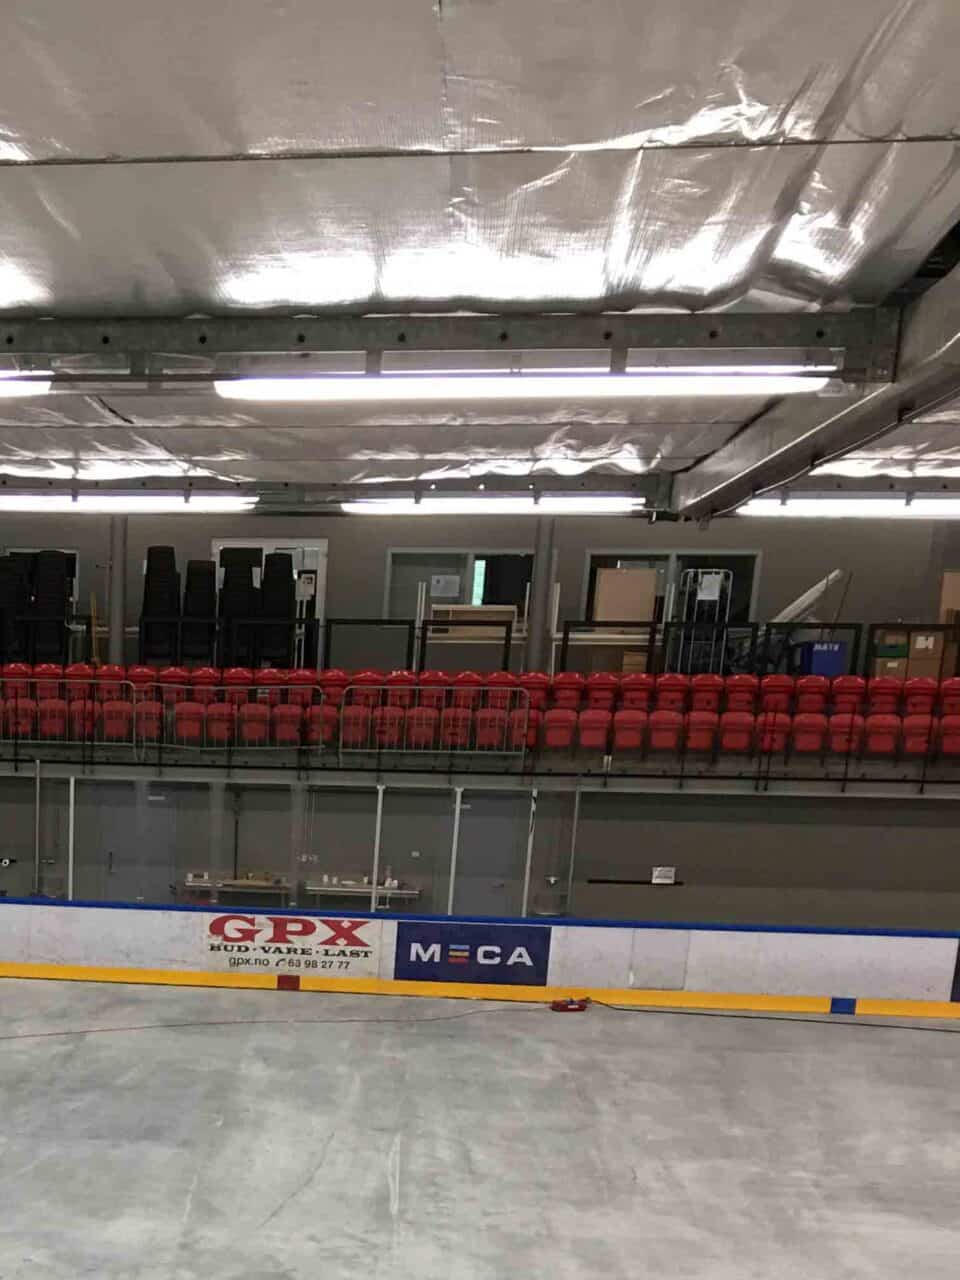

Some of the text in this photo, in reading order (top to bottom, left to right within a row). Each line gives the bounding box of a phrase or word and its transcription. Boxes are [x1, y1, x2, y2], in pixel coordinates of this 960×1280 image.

[208, 914, 371, 948] GPX
[260, 945, 312, 956] VARE
[323, 948, 373, 959] LAST
[409, 942, 534, 967] MECA
[228, 956, 270, 968] gpx.no
